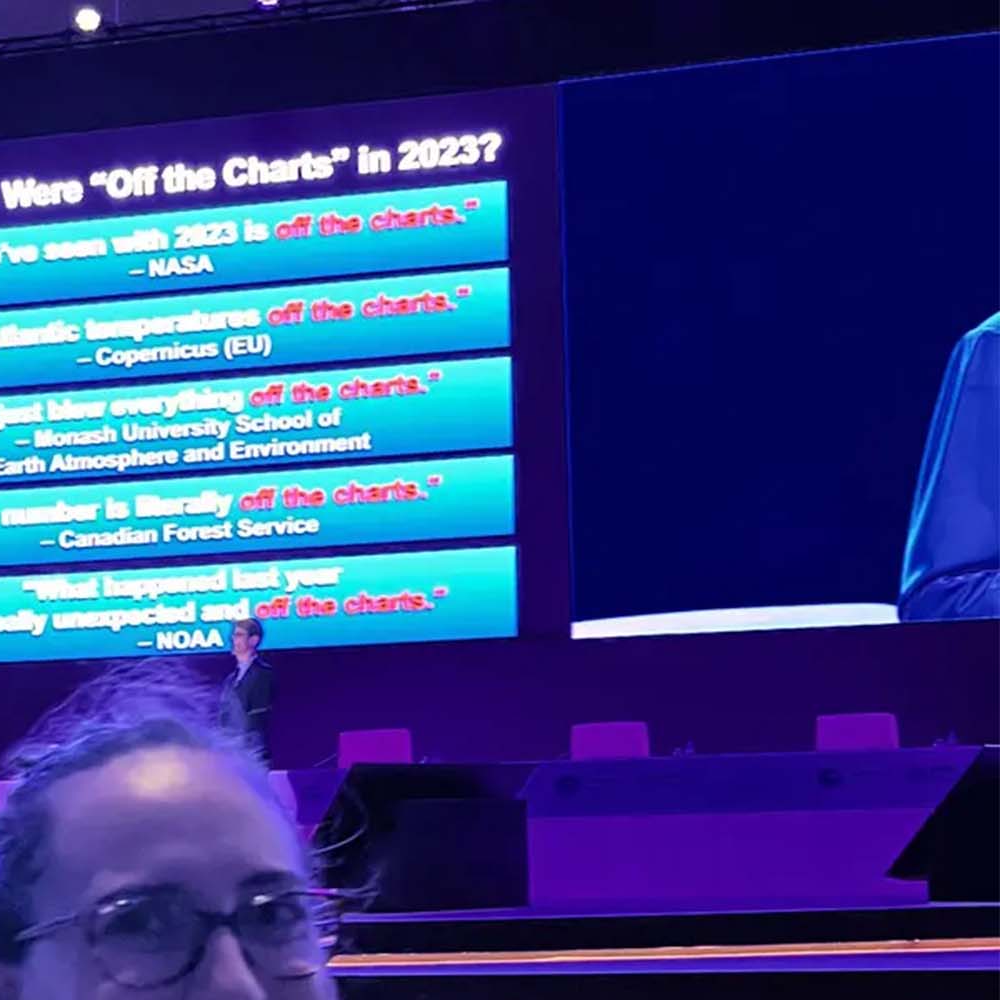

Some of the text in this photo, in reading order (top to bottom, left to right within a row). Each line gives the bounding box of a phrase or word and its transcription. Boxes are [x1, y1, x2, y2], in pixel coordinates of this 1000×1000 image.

[1, 178, 83, 208] Were
[162, 163, 216, 192] the
[358, 145, 391, 174] in
[398, 132, 502, 170] 2023?
[44, 239, 107, 260] seen
[111, 228, 168, 253] with
[175, 221, 238, 248] 2023
[244, 219, 269, 241] is
[274, 216, 314, 240] off
[318, 211, 364, 236] the
[149, 256, 213, 277] NASA
[85, 309, 261, 342] temperatures
[266, 302, 305, 326] off
[309, 298, 355, 322] the
[96, 343, 219, 368] Copernicus
[225, 335, 272, 360] (EU)
[47, 396, 106, 421] blew
[110, 388, 245, 416] everything
[249, 384, 285, 408] off
[291, 379, 332, 404] the
[34, 426, 117, 448] Monash
[122, 418, 231, 442] University
[235, 411, 313, 433] School
[318, 408, 342, 427] of
[49, 448, 179, 472] Atmosphere
[183, 442, 225, 463] and
[230, 433, 371, 460] Environment
[1, 500, 101, 526] number
[106, 496, 130, 520] is
[135, 491, 234, 518] literally
[238, 488, 276, 511] off
[281, 484, 328, 508] the
[58, 528, 158, 549] Canadian
[163, 521, 233, 542] Forest
[237, 517, 320, 537] Service
[102, 569, 227, 601] happened
[231, 565, 281, 590] last
[283, 562, 343, 592] year
[52, 600, 196, 632] unexpected
[200, 599, 251, 622] and
[255, 598, 290, 619] off
[296, 594, 338, 616] the
[156, 629, 224, 650] NOAA
